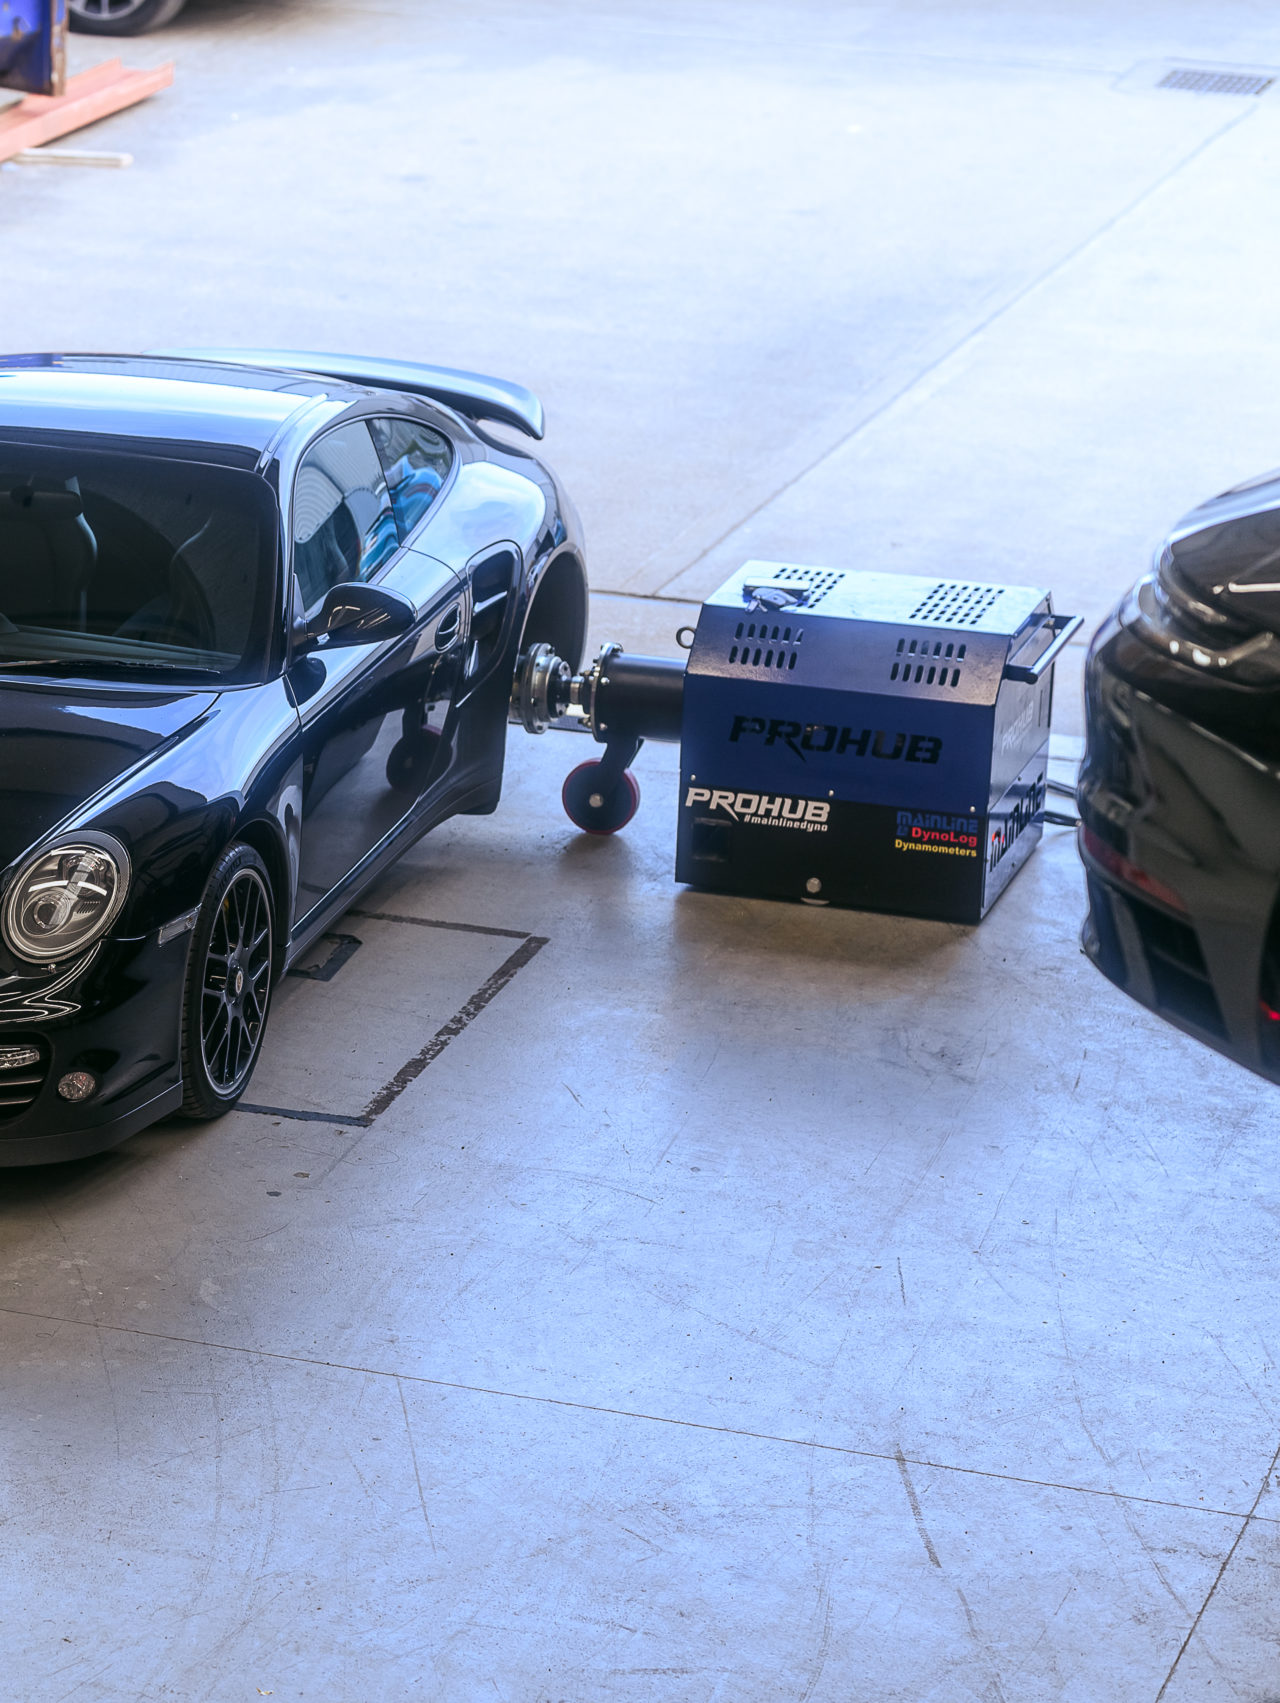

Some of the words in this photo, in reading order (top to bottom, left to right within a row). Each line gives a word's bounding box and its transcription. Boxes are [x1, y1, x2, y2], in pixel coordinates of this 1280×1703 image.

[728, 715, 943, 764] PROHUB
[685, 787, 831, 822] PROHUB
[744, 814, 829, 832] #mainlinedyno
[911, 826, 977, 847] DynoLog
[895, 839, 977, 857] Dynamometers
